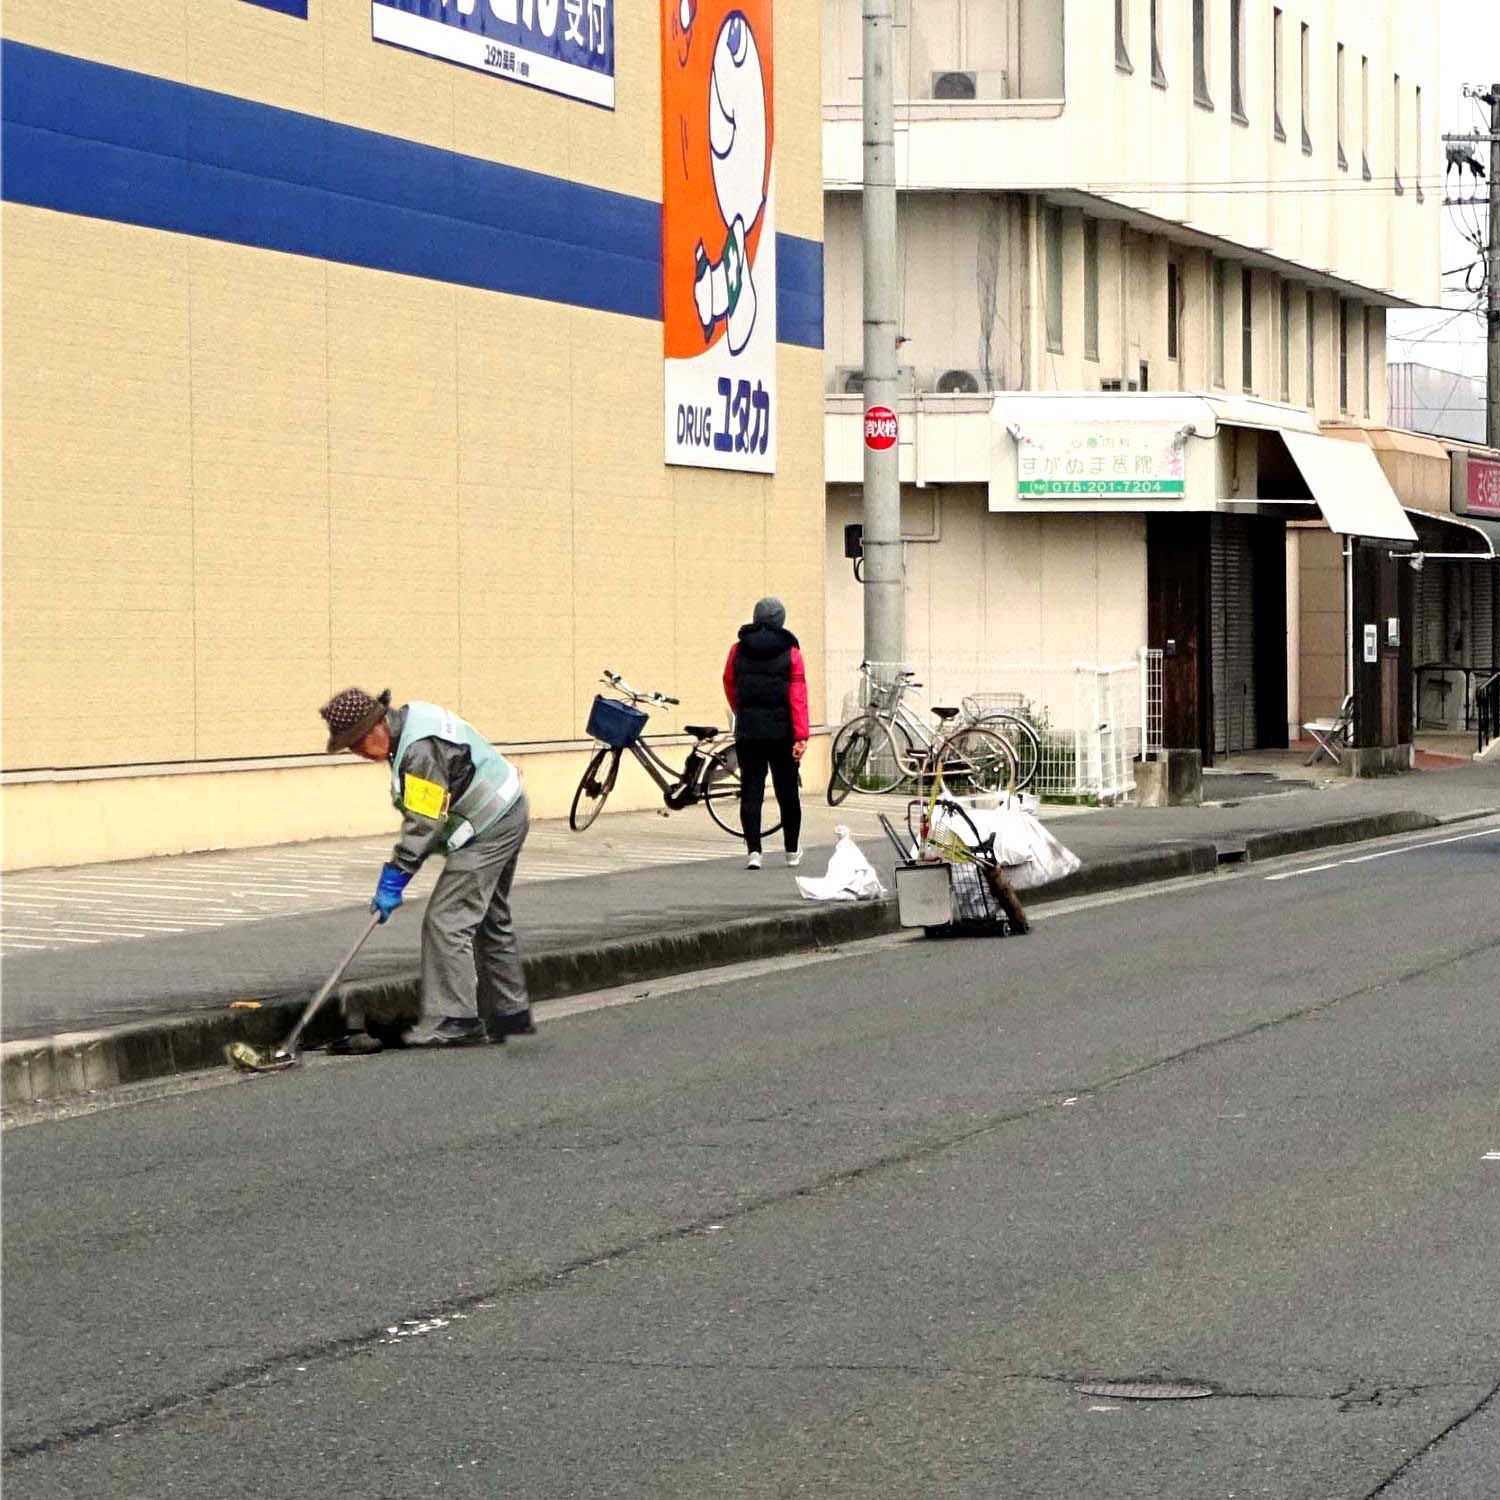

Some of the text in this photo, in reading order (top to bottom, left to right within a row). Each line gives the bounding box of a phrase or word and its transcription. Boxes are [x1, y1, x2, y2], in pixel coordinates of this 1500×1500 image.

[676, 376, 770, 455] DRUG ユタカ
[864, 419, 897, 438] 消火栓
[1022, 455, 1153, 475] すがぬま医院
